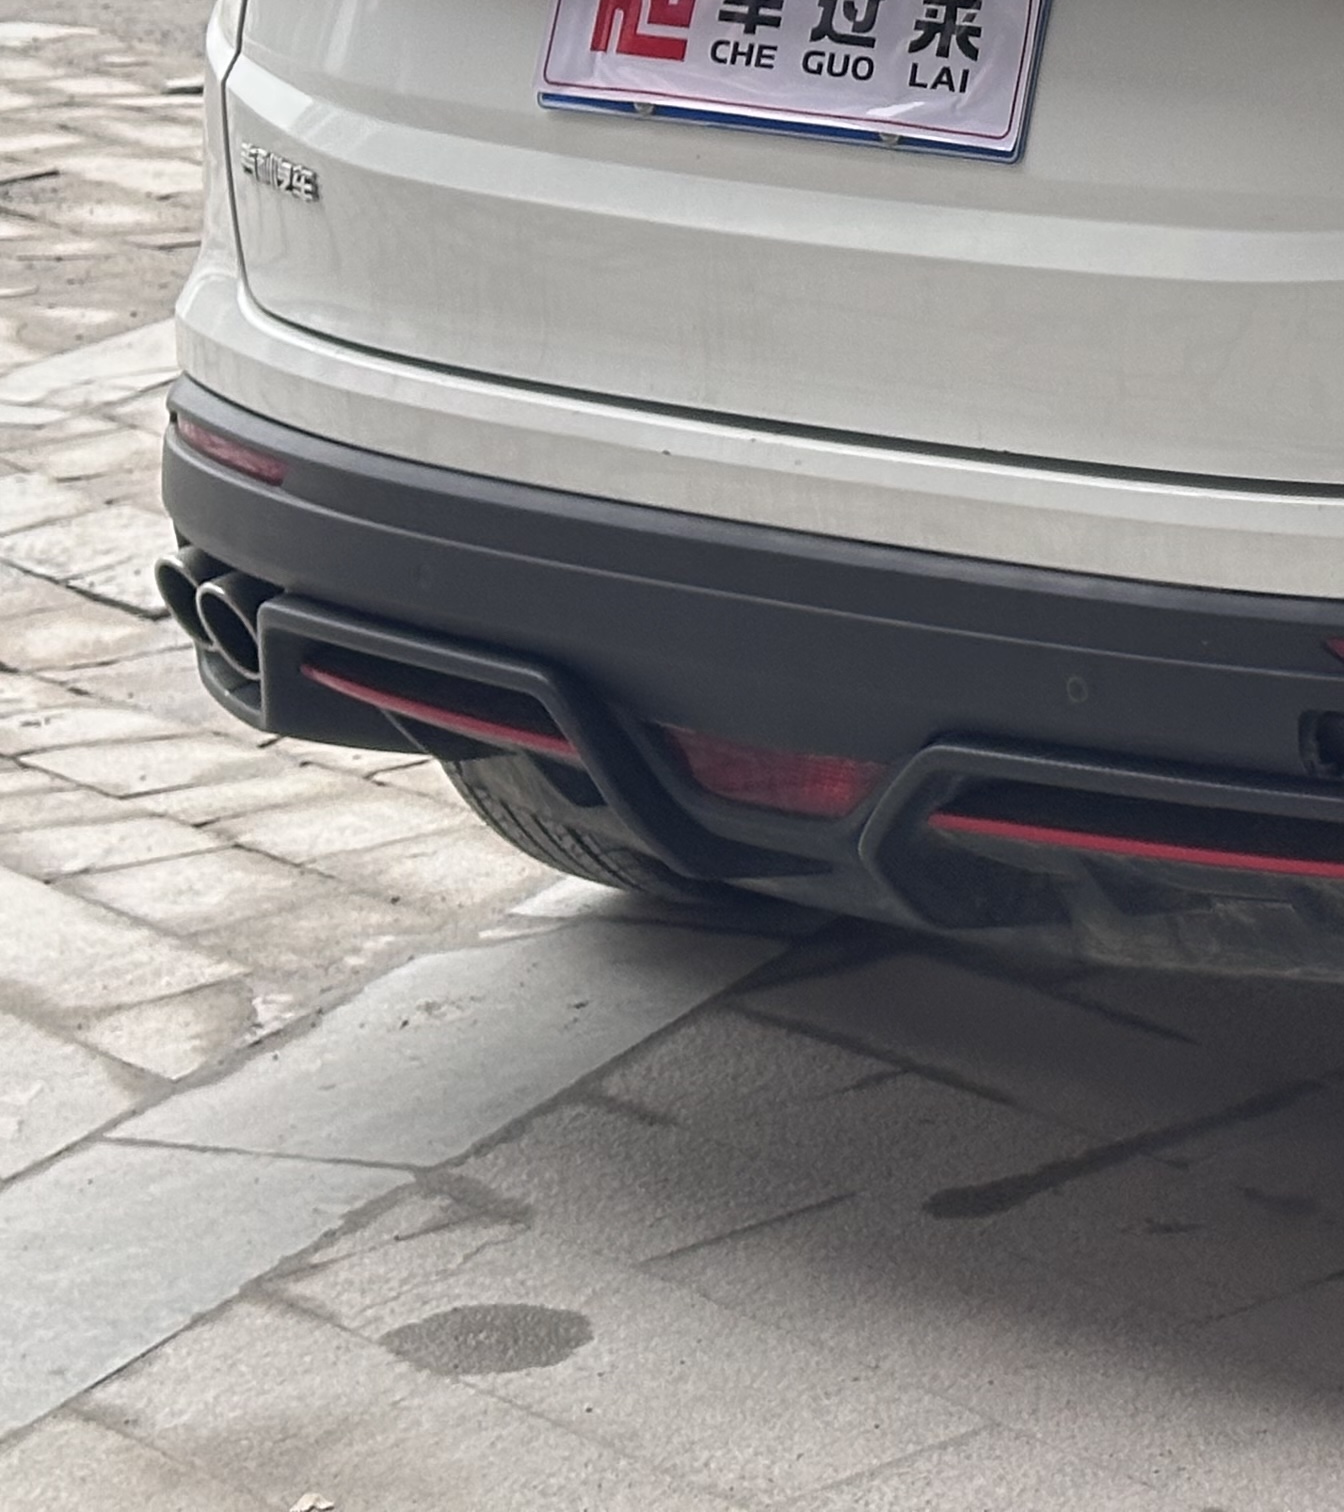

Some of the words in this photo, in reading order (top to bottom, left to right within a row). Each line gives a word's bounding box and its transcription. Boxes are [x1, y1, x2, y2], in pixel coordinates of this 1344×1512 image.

[709, 39, 779, 70] CHE
[801, 49, 875, 81] GUO
[907, 62, 970, 94] LAI
